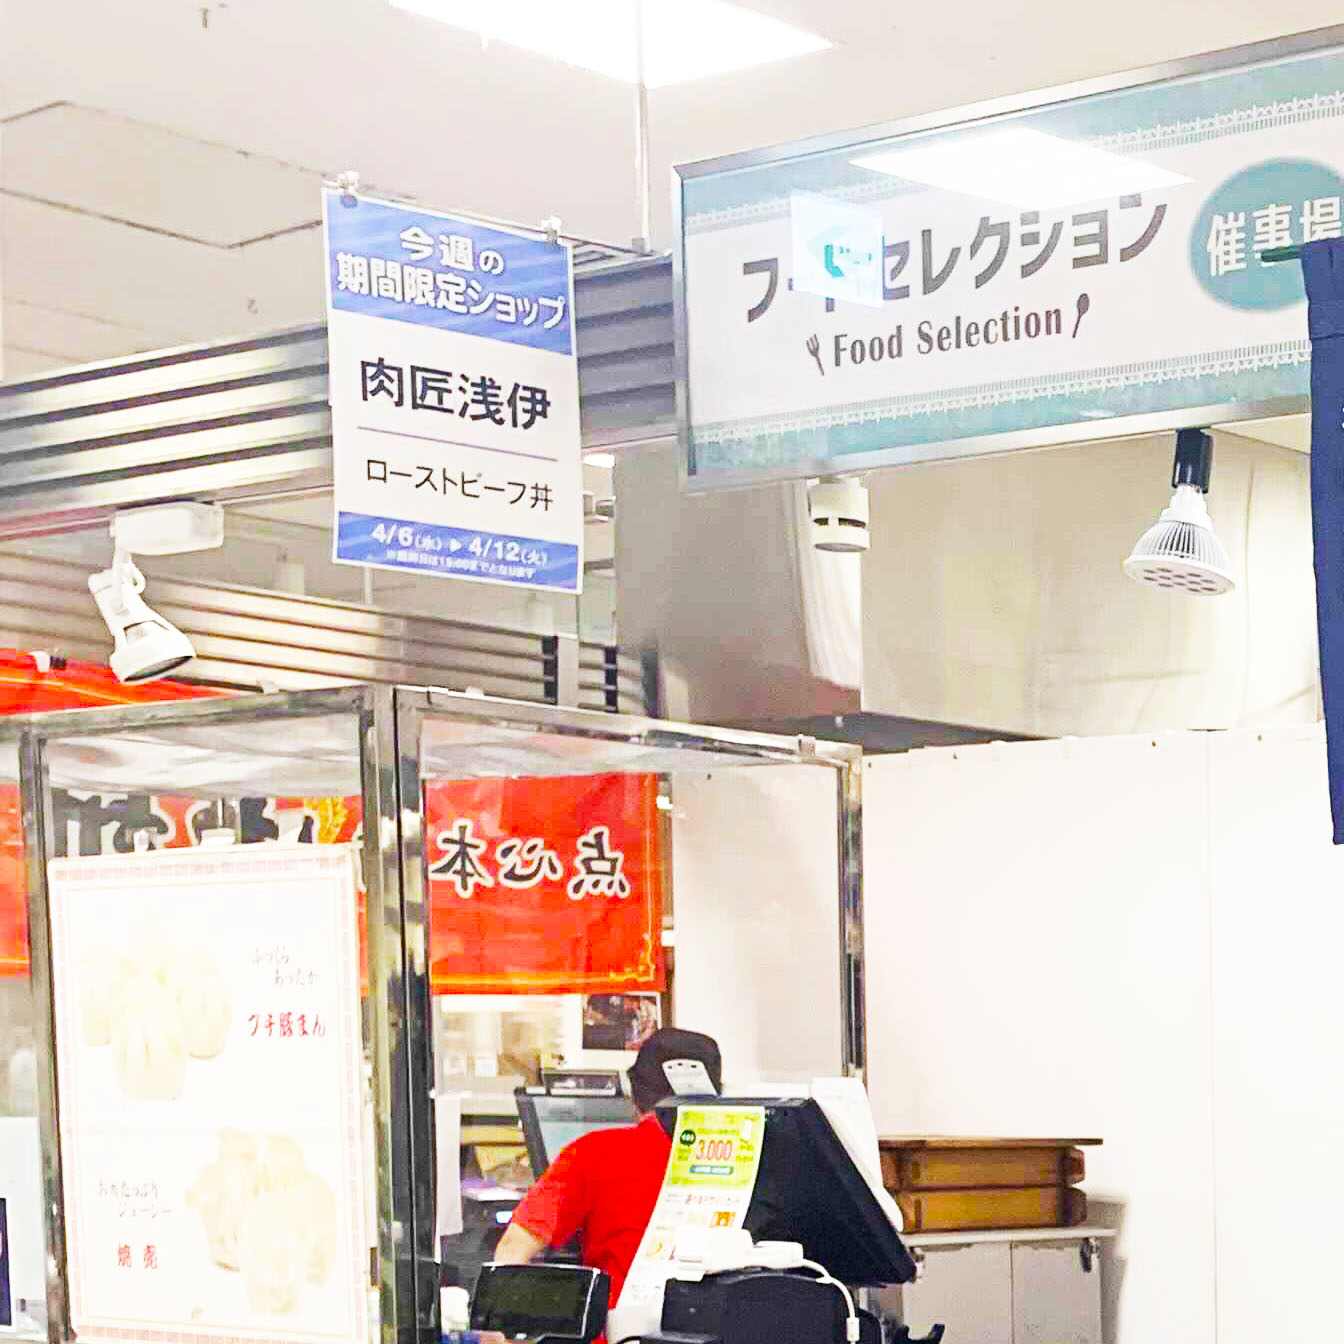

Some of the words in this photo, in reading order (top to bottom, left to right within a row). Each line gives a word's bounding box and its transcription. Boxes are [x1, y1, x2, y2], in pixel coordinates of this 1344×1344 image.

[400, 226, 505, 275] 今週の
[336, 251, 566, 330] 期間限定ショップ
[833, 326, 904, 368] Food
[917, 303, 1064, 353] Selection
[360, 357, 552, 431] 肉匠浅伊
